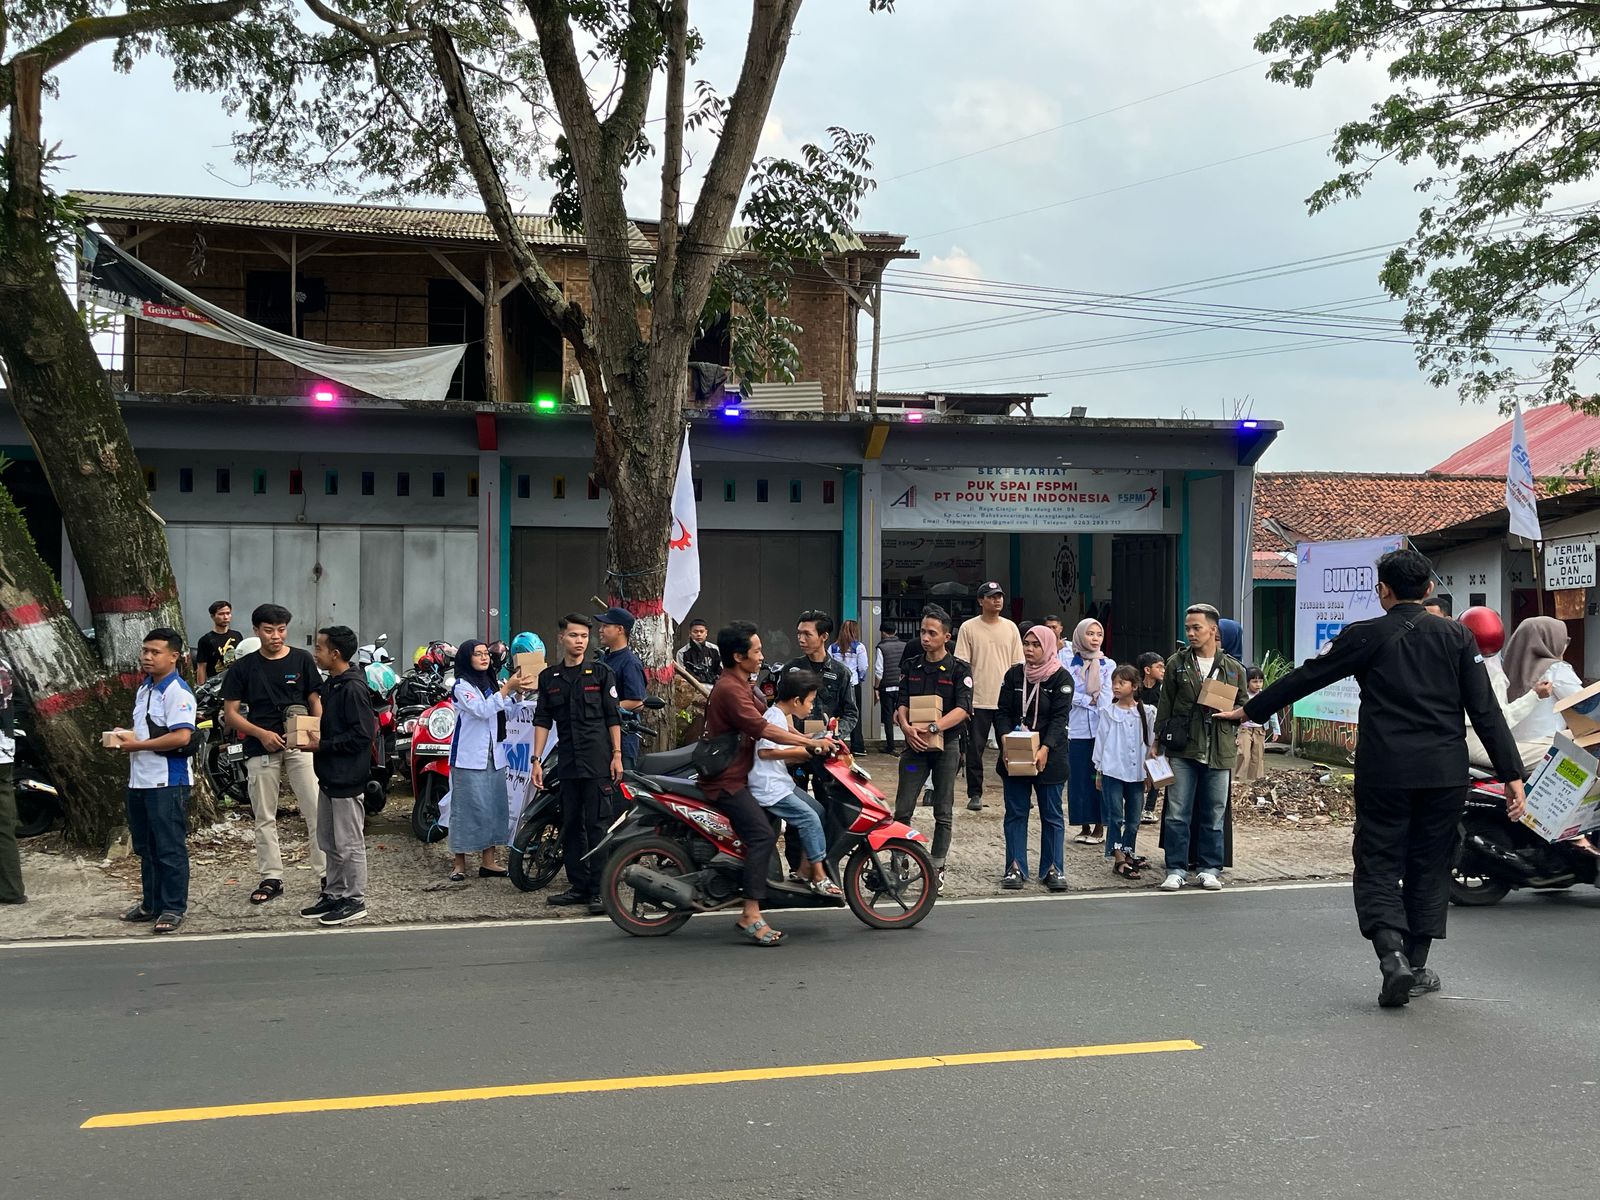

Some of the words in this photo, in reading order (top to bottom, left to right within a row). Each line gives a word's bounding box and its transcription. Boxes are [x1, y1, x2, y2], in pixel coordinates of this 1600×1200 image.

[967, 480, 995, 490] PUK
[1000, 481, 1031, 491] SPAI
[1036, 481, 1078, 492] FSPMI
[934, 492, 950, 502] PT
[956, 492, 984, 502] POU
[989, 492, 1027, 502] YUEN
[1033, 493, 1110, 503] INDONESIA
[1118, 493, 1146, 502] FSPMI
[1554, 545, 1587, 555] TERIMA
[1560, 566, 1580, 576] DAN
[1323, 566, 1373, 592] BUKBER
[1558, 758, 1587, 782] bindex
